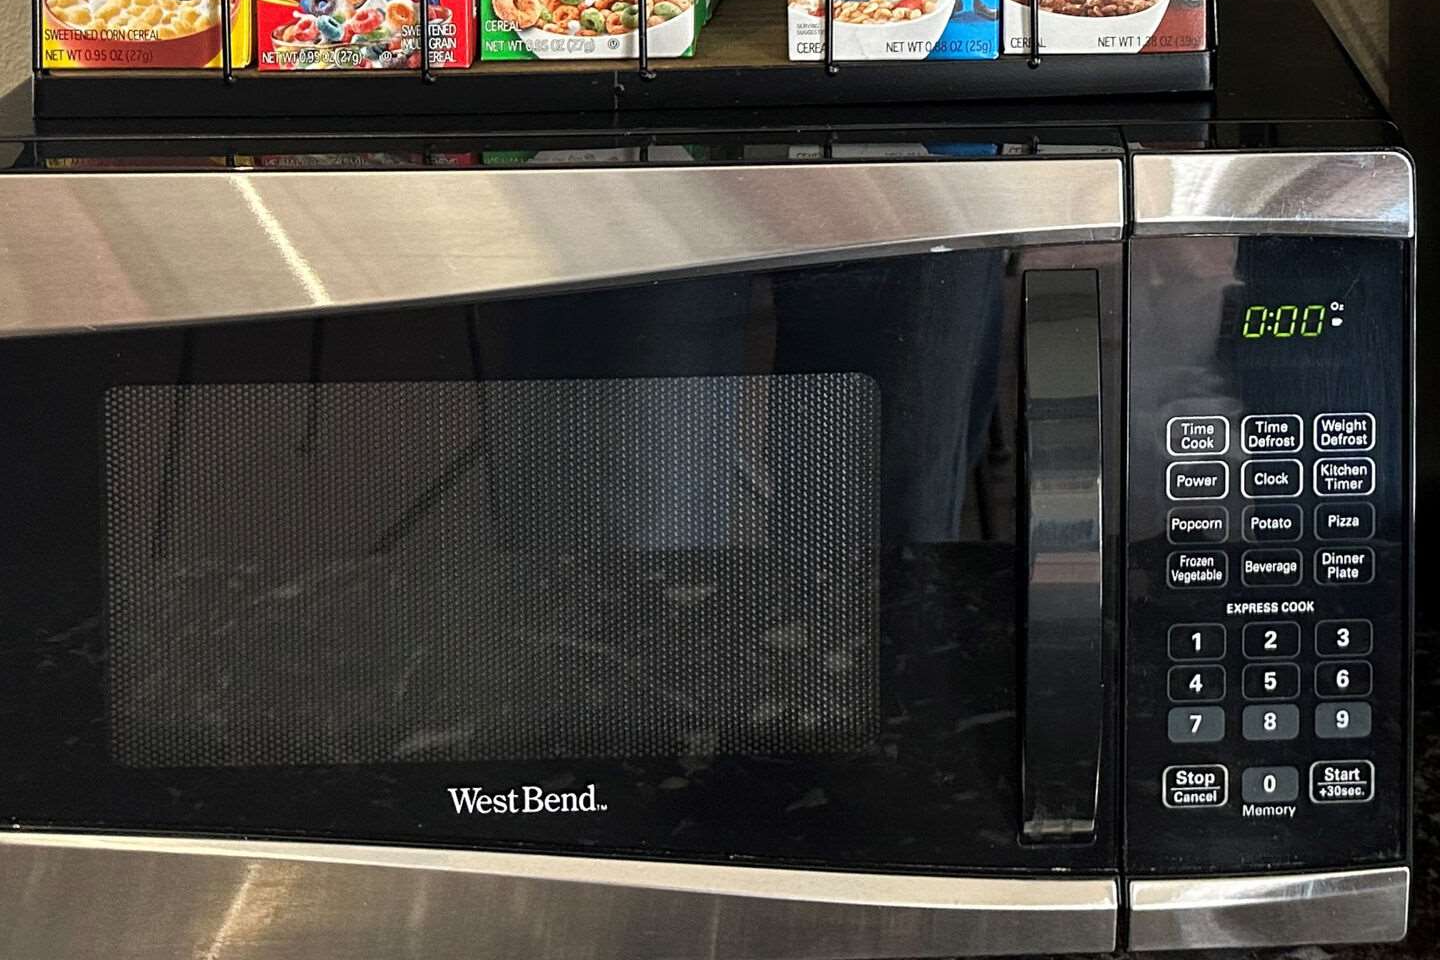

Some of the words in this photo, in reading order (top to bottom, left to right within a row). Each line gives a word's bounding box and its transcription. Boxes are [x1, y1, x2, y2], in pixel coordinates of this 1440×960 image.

[100, 29, 126, 40] CORN
[127, 29, 160, 40] CEREAL
[886, 42, 904, 52] NET
[45, 50, 63, 61] NET
[1242, 305, 1326, 338] 0:00
[1181, 423, 1214, 435] Time
[1255, 421, 1288, 434] Time
[1321, 419, 1367, 433] Weight
[1181, 437, 1214, 450] Cook
[1249, 435, 1295, 448] Defrost
[1321, 433, 1368, 446] Defrost
[1320, 464, 1368, 477] Kitchen
[1176, 474, 1217, 487] Power
[1254, 473, 1288, 486] Clock
[1325, 478, 1363, 490] Timer
[1171, 518, 1222, 532] Popcorn
[1250, 517, 1292, 530] Potato
[1327, 515, 1359, 527] Pizza
[1179, 556, 1214, 568] Frozen
[1322, 553, 1365, 565] Dinner
[1245, 561, 1297, 574] Beverage
[1327, 567, 1359, 579] Plate
[1171, 569, 1222, 583] Vegetable
[1226, 602, 1279, 615] EXPRESS
[1281, 601, 1315, 613] COOK
[1191, 632, 1202, 651] 1
[1264, 631, 1277, 650] 2
[1336, 628, 1350, 647] 3
[1189, 674, 1203, 693] 4
[1264, 672, 1277, 690] 5
[1336, 670, 1350, 689] 6
[1190, 715, 1202, 733] 7
[1263, 712, 1277, 731] 8
[1336, 710, 1349, 728] 9
[1175, 771, 1215, 787] Stop
[1324, 767, 1360, 781] Start
[1263, 775, 1277, 793] 0
[1173, 790, 1217, 803] Cancel
[1319, 785, 1365, 797] +30sec.
[1242, 804, 1296, 817] Memory
